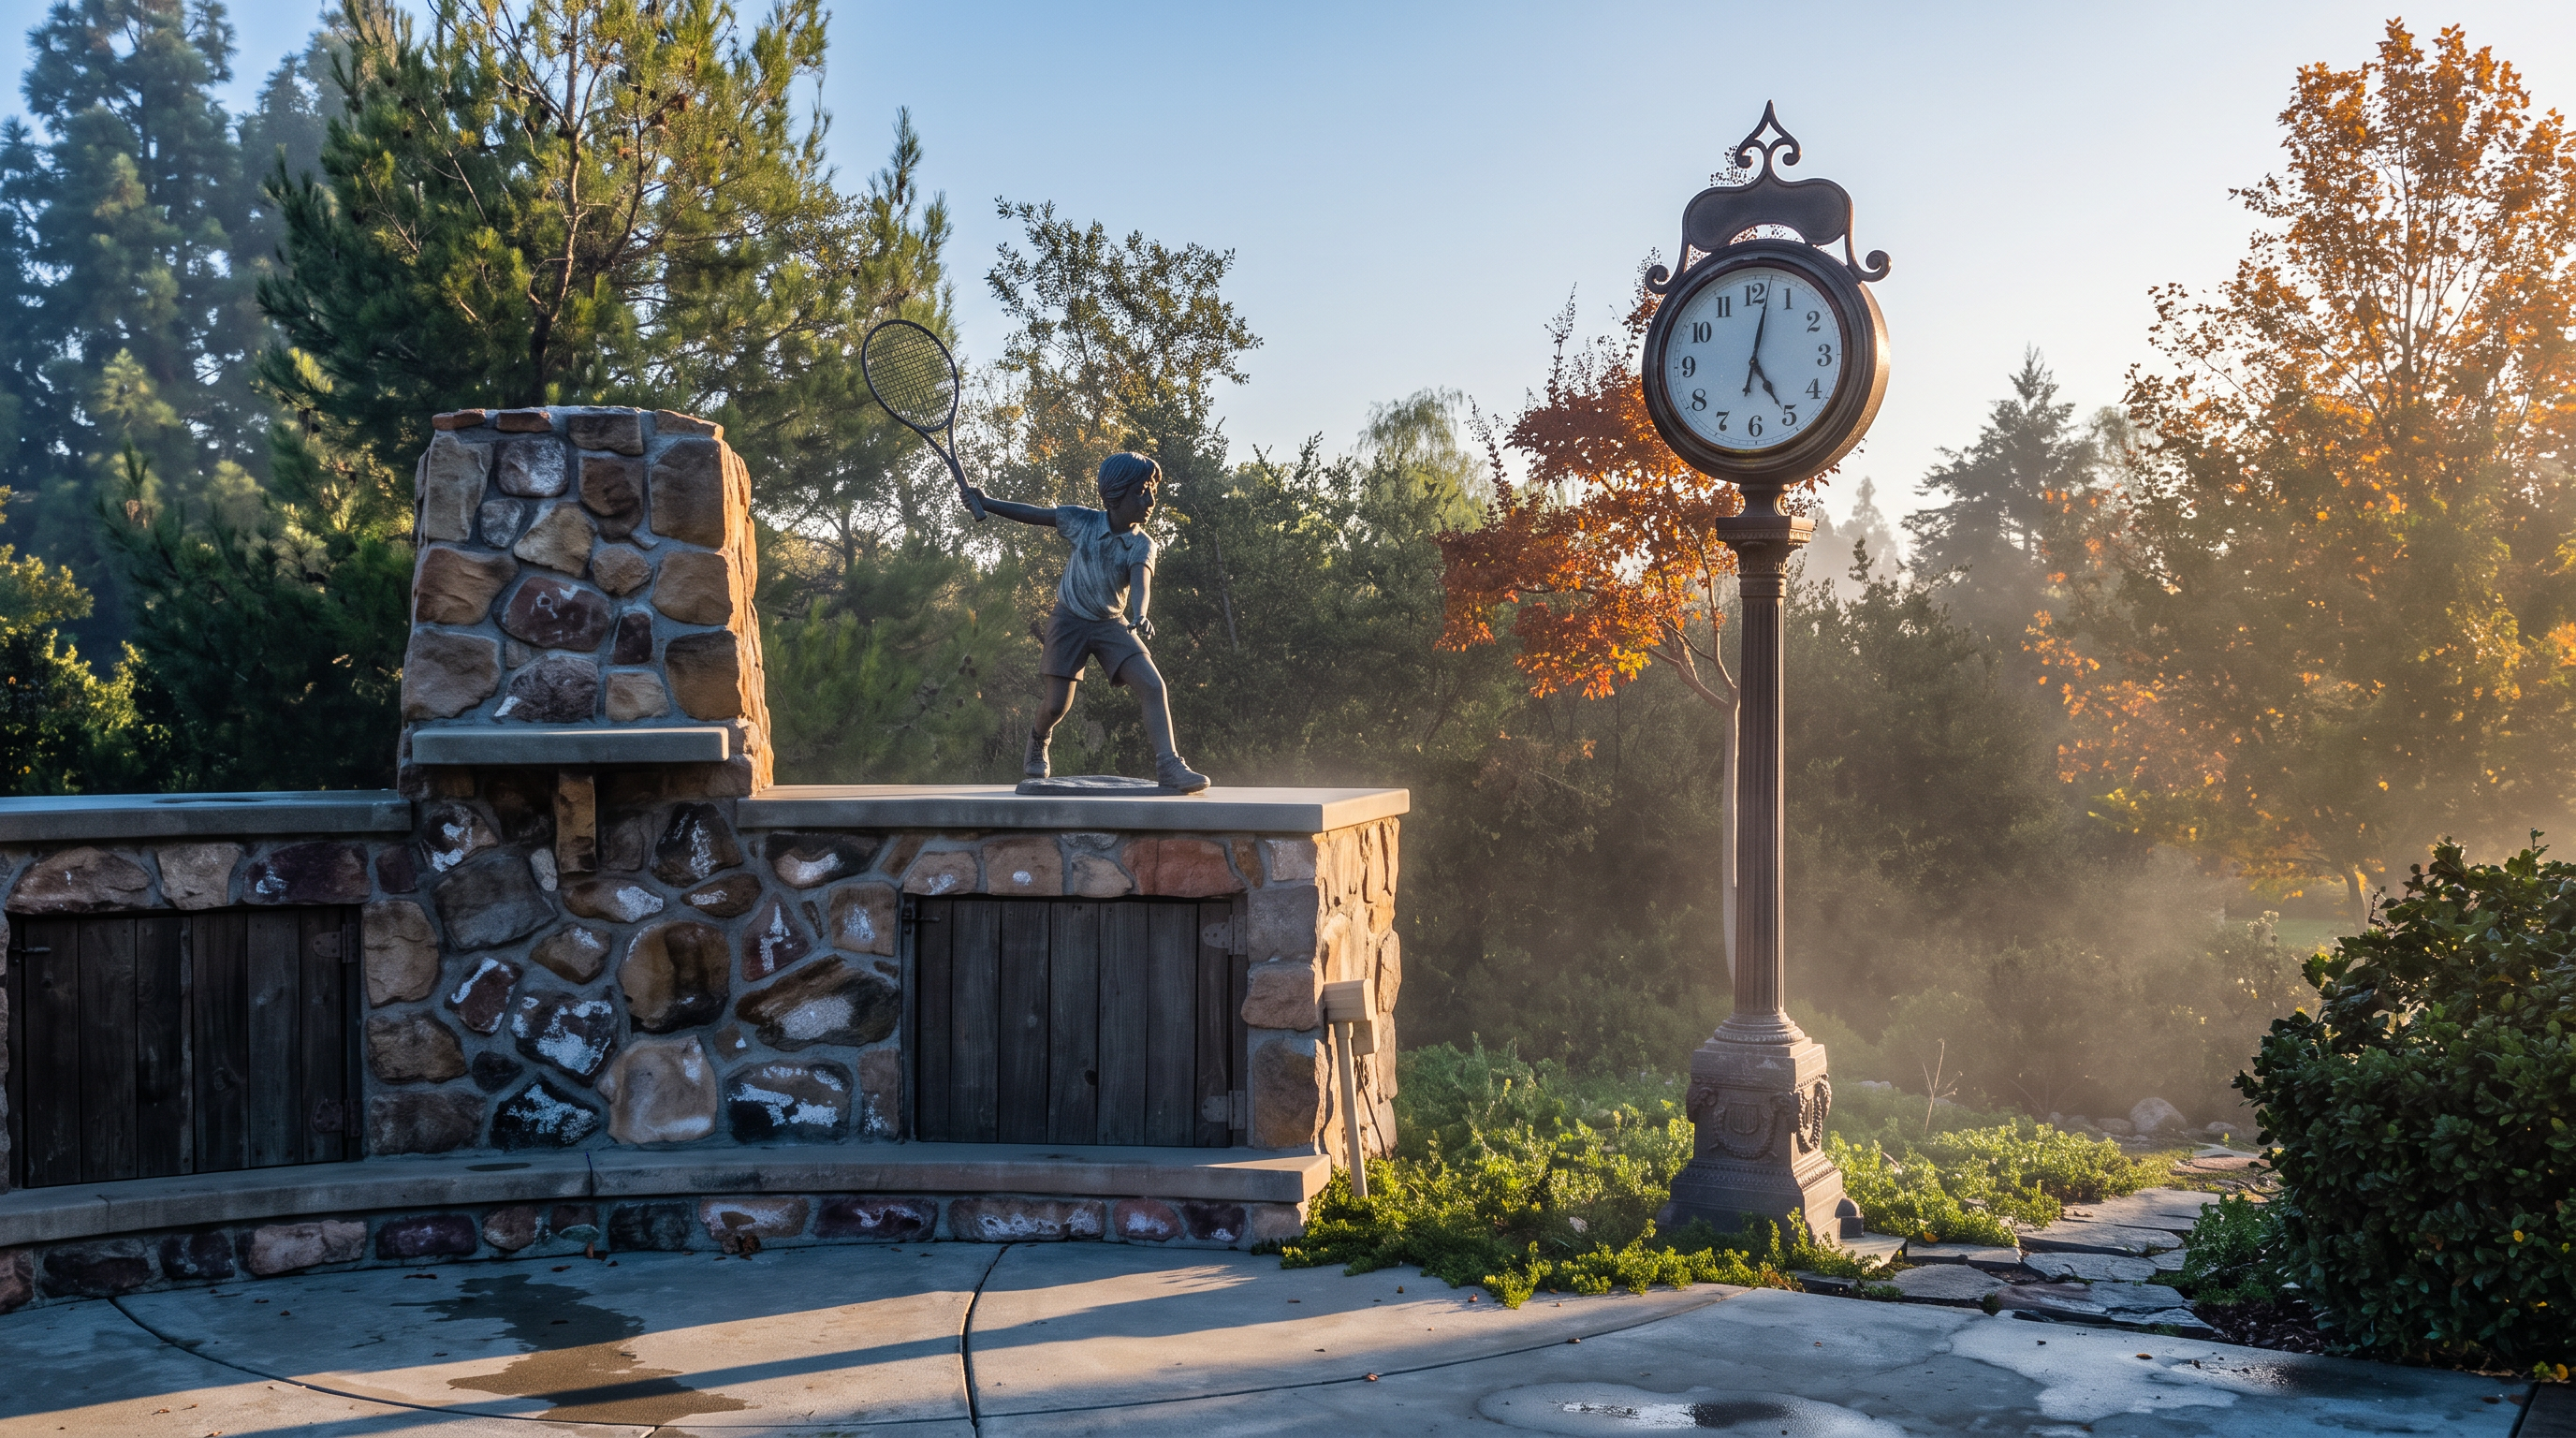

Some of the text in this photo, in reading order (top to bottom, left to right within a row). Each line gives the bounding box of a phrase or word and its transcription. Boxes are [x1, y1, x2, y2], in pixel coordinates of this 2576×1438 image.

[1744, 283, 1765, 306] 12
[1784, 288, 1793, 310] 1
[1716, 296, 1732, 318] 11
[1691, 321, 1712, 344] 10
[1807, 311, 1821, 333] 2
[1682, 356, 1696, 378] 9
[1817, 345, 1832, 367] 3
[1691, 389, 1707, 411] 8
[1806, 378, 1822, 400] 4
[1716, 411, 1730, 432] 7
[1748, 415, 1763, 437] 6
[1781, 404, 1797, 426] 5
